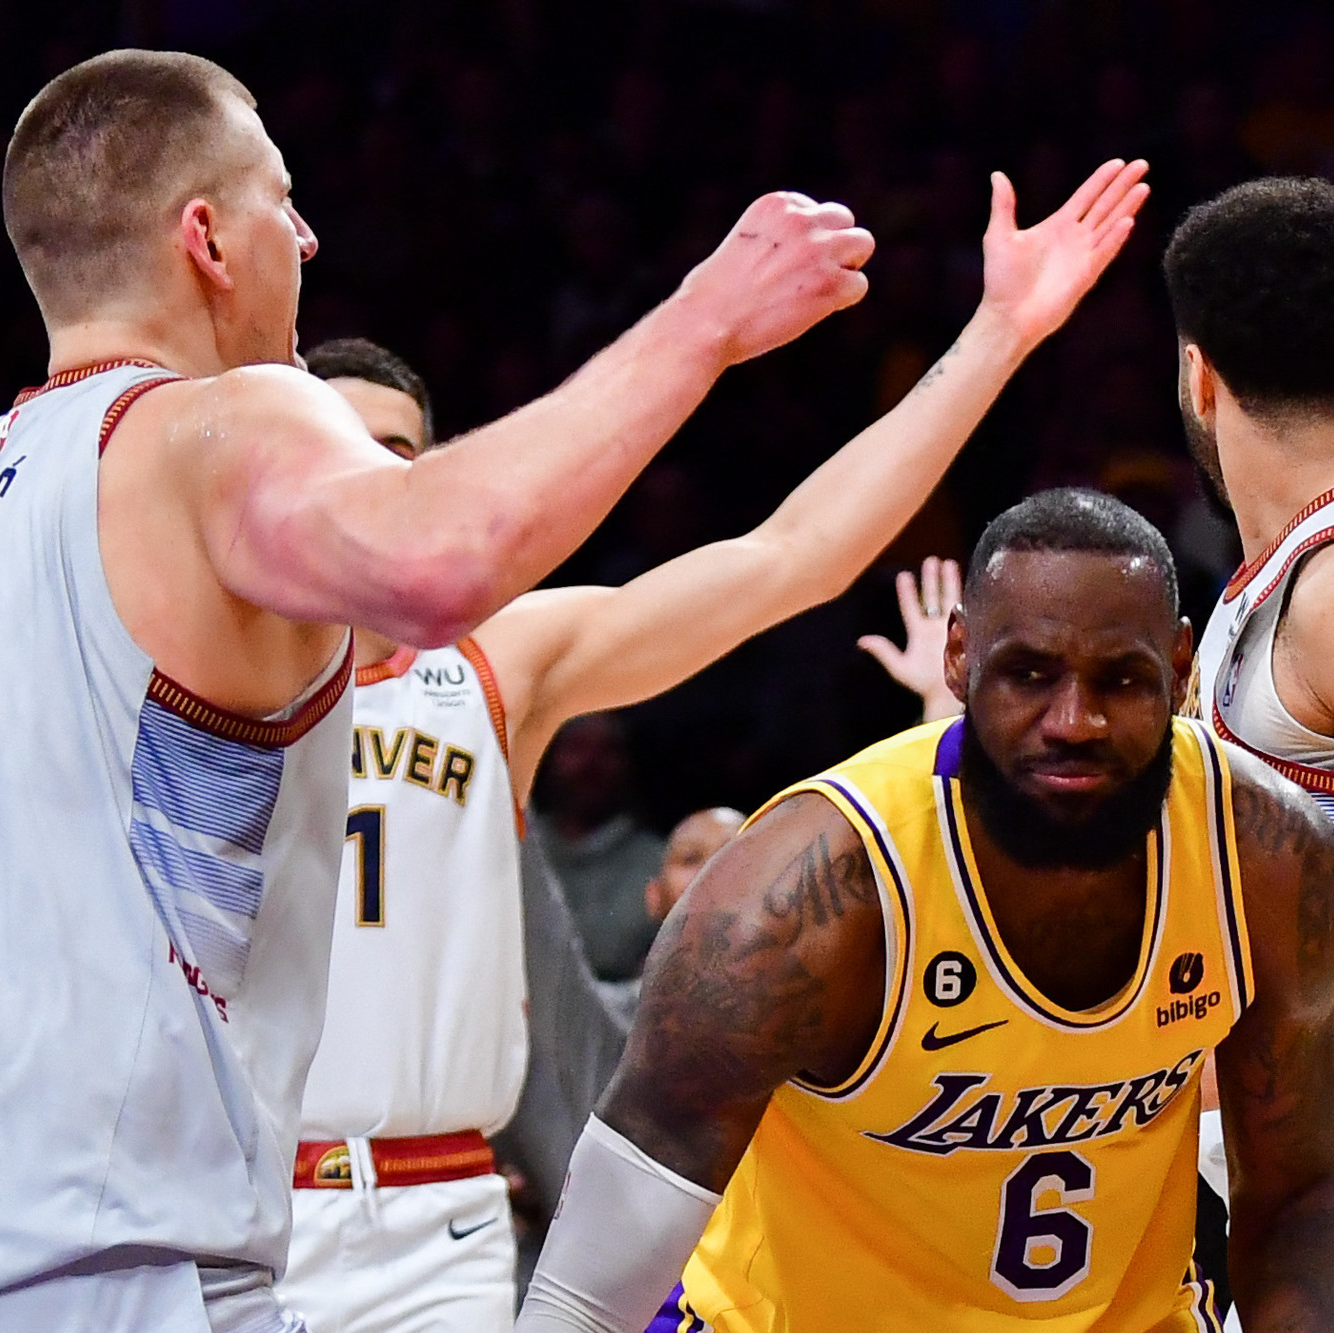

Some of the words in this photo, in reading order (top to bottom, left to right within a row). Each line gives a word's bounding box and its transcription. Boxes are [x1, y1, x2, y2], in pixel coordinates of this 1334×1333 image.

[414, 664, 465, 687] WU
[345, 804, 385, 927] 1
[934, 959, 962, 1000] 6
[1156, 991, 1220, 1028] bibigo
[860, 1047, 1207, 1157] LAKERS
[990, 1149, 1096, 1302] 6
